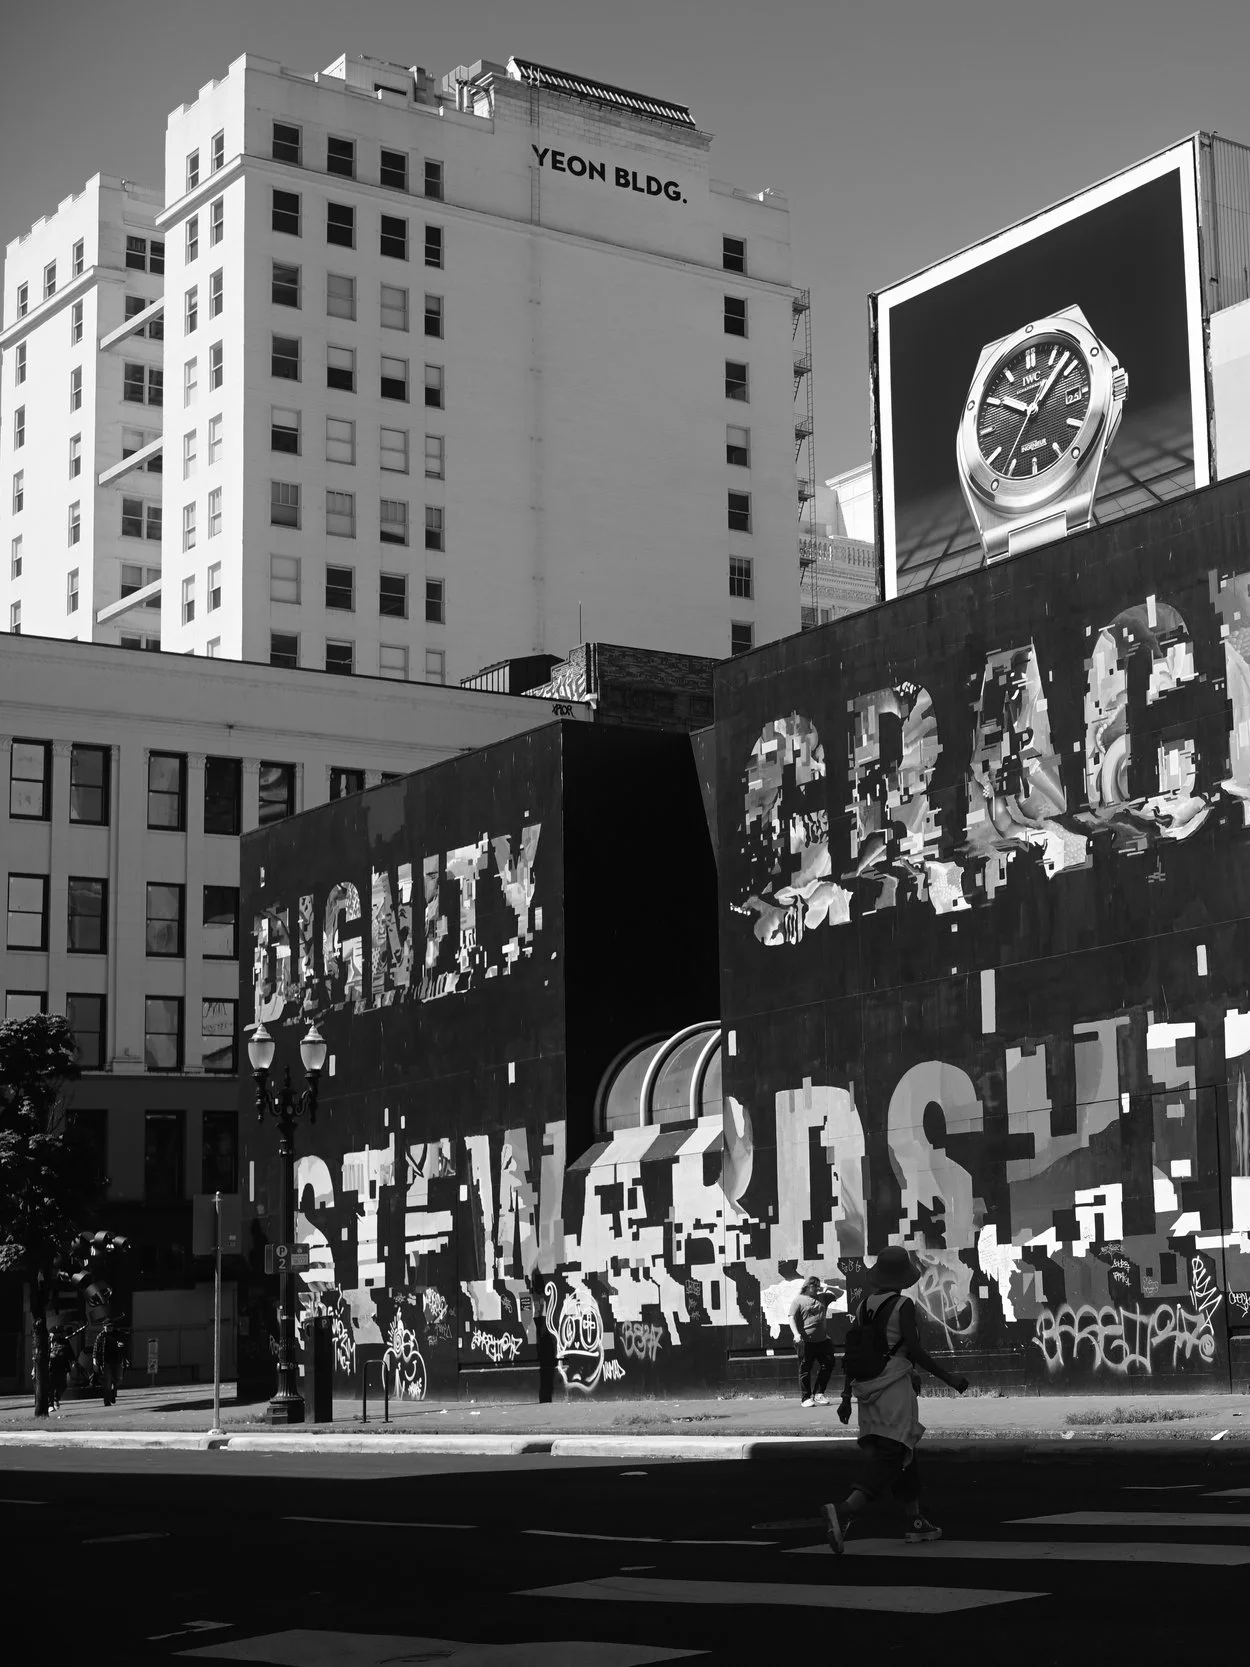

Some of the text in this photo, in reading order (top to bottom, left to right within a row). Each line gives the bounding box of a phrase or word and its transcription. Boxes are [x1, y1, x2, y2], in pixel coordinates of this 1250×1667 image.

[531, 144, 688, 204] YEON BLDG.
[1022, 371, 1041, 387] IWC
[1067, 394, 1080, 403] 25
[251, 822, 545, 1030] DIGNITY
[278, 1258, 287, 1269] 2
